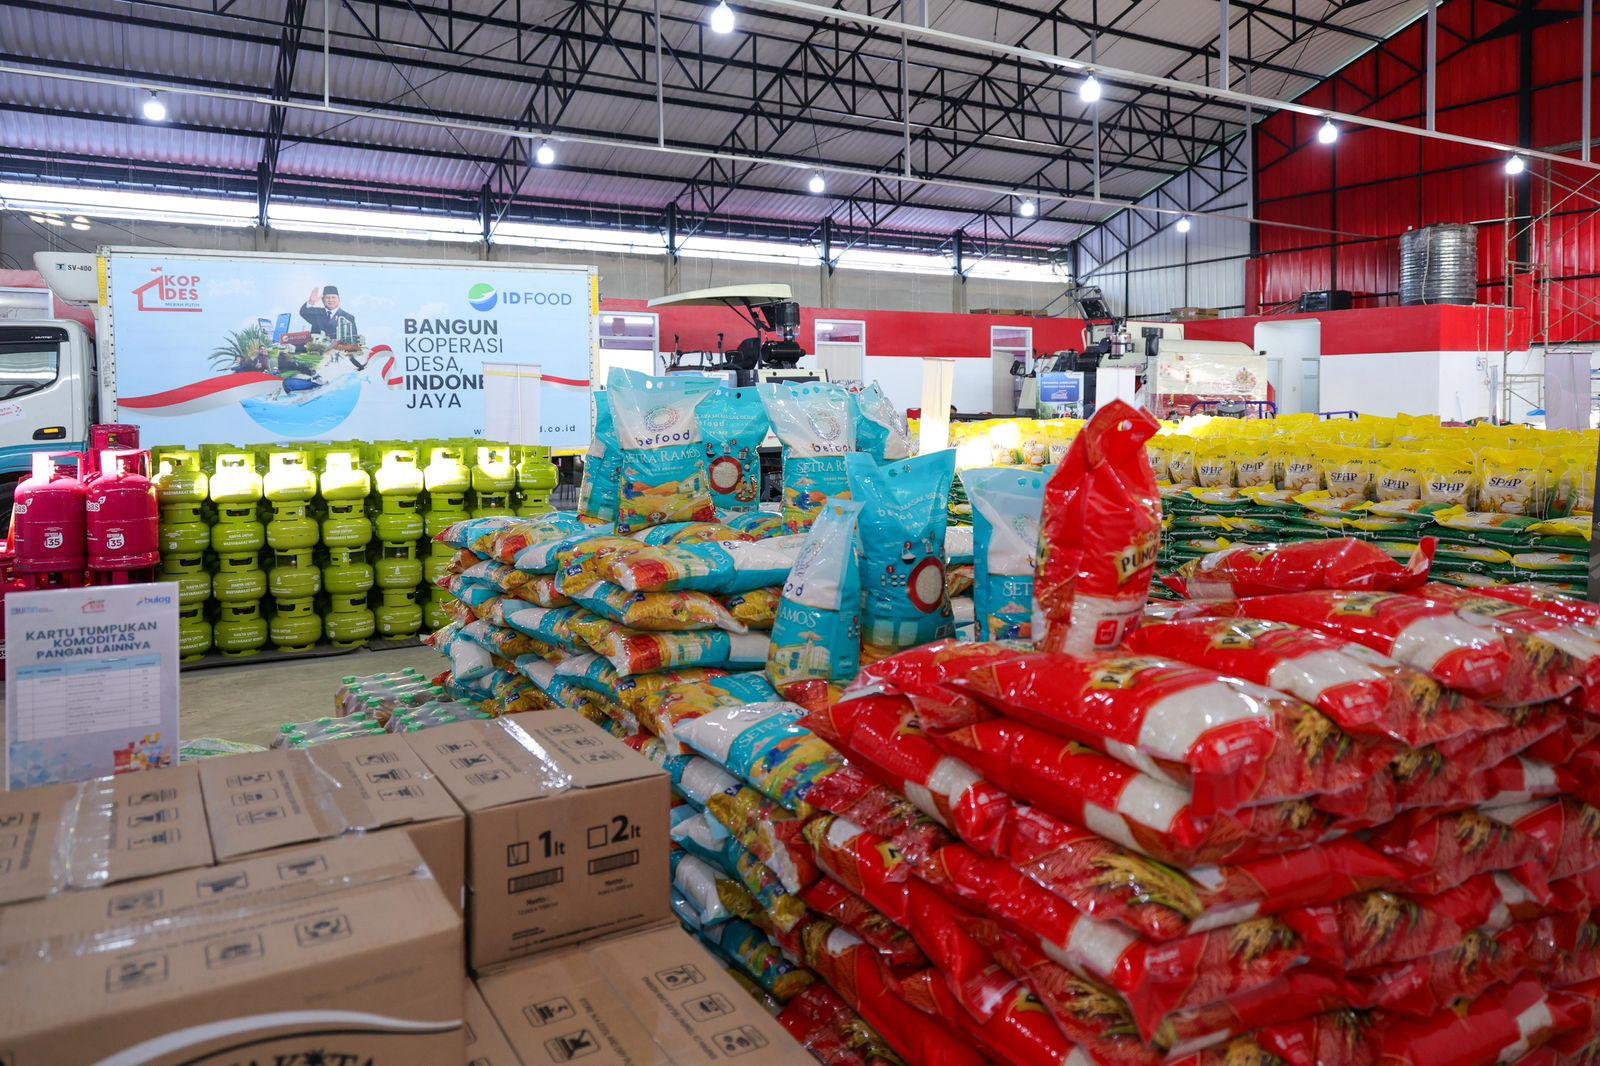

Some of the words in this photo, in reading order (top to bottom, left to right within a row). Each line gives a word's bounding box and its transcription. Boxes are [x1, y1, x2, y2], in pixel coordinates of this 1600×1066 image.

[67, 264, 92, 272] SV-400
[164, 275, 201, 287] KOP
[164, 288, 200, 301] DES
[503, 292, 521, 304] ID
[524, 293, 573, 306] FOOD
[404, 318, 499, 335] BANGUN
[405, 337, 503, 353] KOPERASI
[405, 356, 464, 374] DESA,
[406, 393, 462, 409] JAYA
[796, 460, 835, 474] SETRA
[1330, 471, 1358, 483] SPHP
[1381, 478, 1410, 490] SPHP
[1488, 477, 1522, 488] SPHP
[1431, 482, 1465, 492] SPHP
[144, 595, 172, 605] bulog
[25, 627, 75, 642] KARTU
[78, 620, 158, 637] TUMPUKAN
[53, 632, 136, 649] KOMODITAS
[36, 645, 93, 660] PANGAN
[96, 641, 151, 655] LAINNYA
[611, 815, 642, 844] 2lt
[538, 830, 567, 859] 1lt
